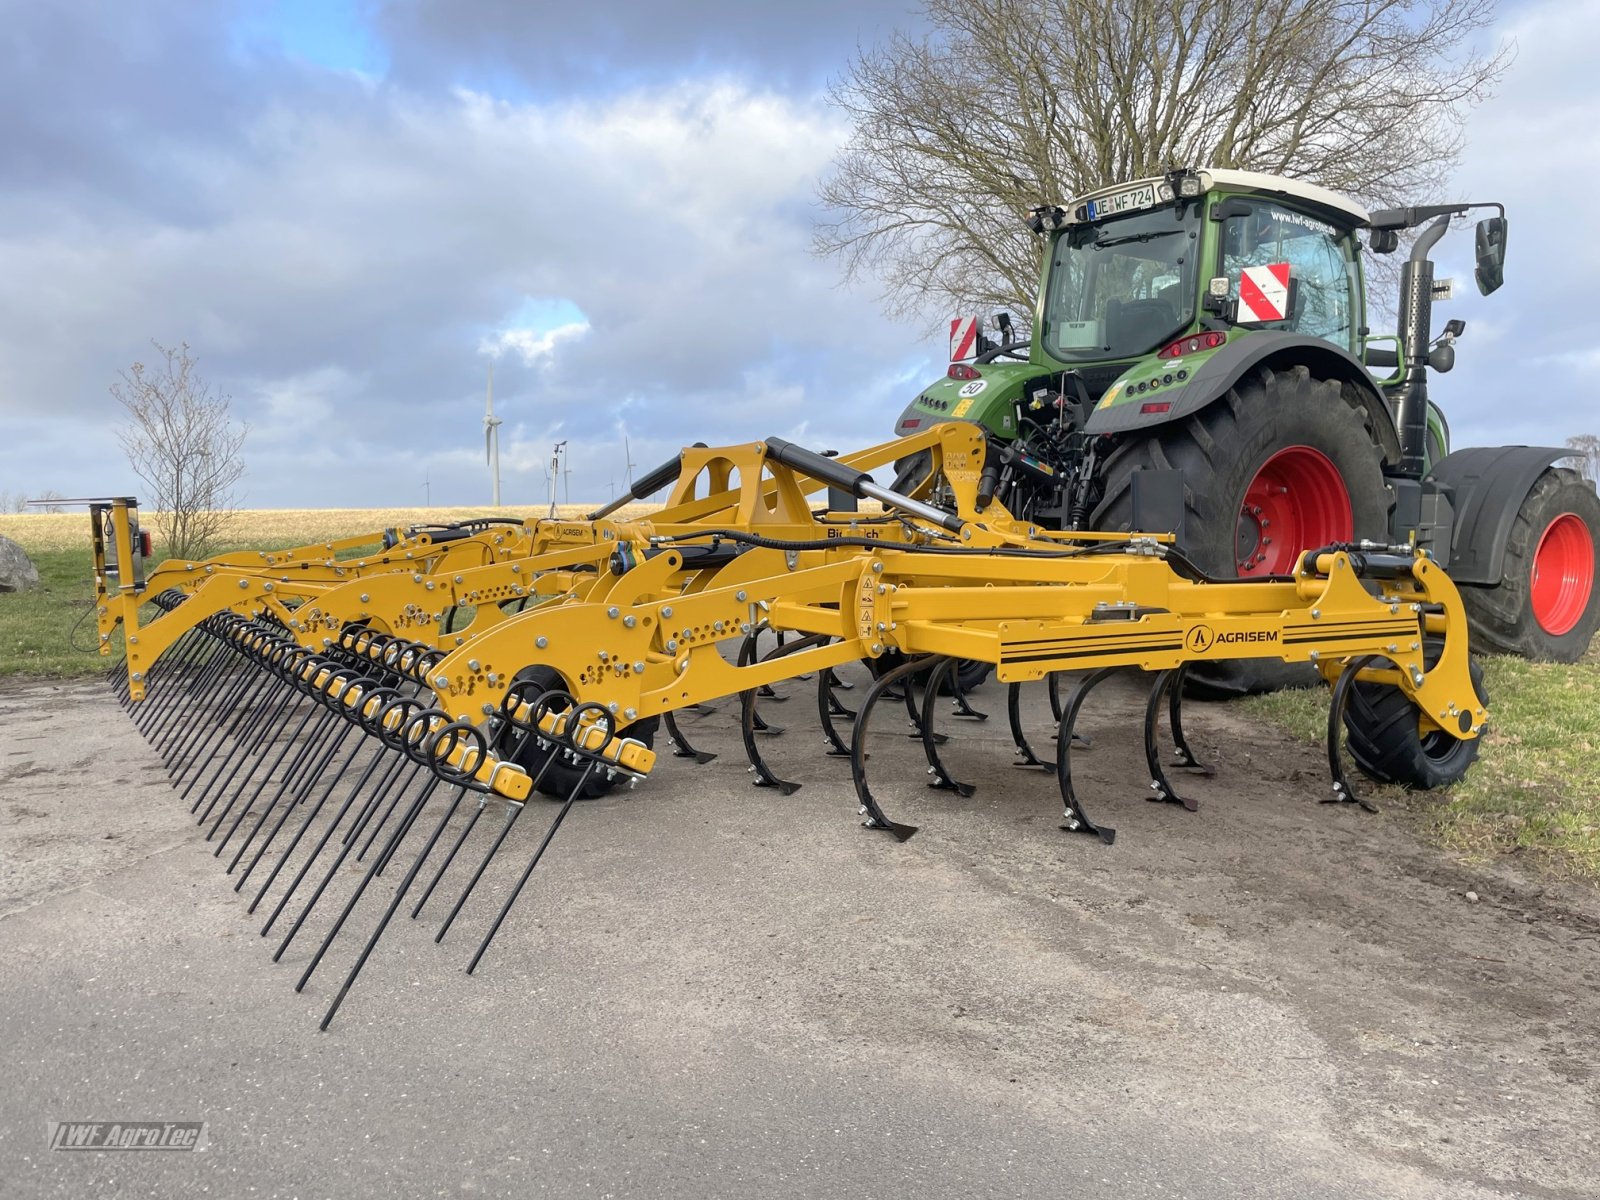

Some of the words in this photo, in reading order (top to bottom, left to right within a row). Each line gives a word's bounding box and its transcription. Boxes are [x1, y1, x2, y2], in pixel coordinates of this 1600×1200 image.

[1094, 199, 1109, 216] UE
[1114, 194, 1128, 211] WF
[1130, 188, 1152, 207] 724
[1270, 210, 1337, 236] www.lwf-agrotec.de
[961, 382, 984, 395] 50
[1215, 630, 1279, 644] AGRISEM
